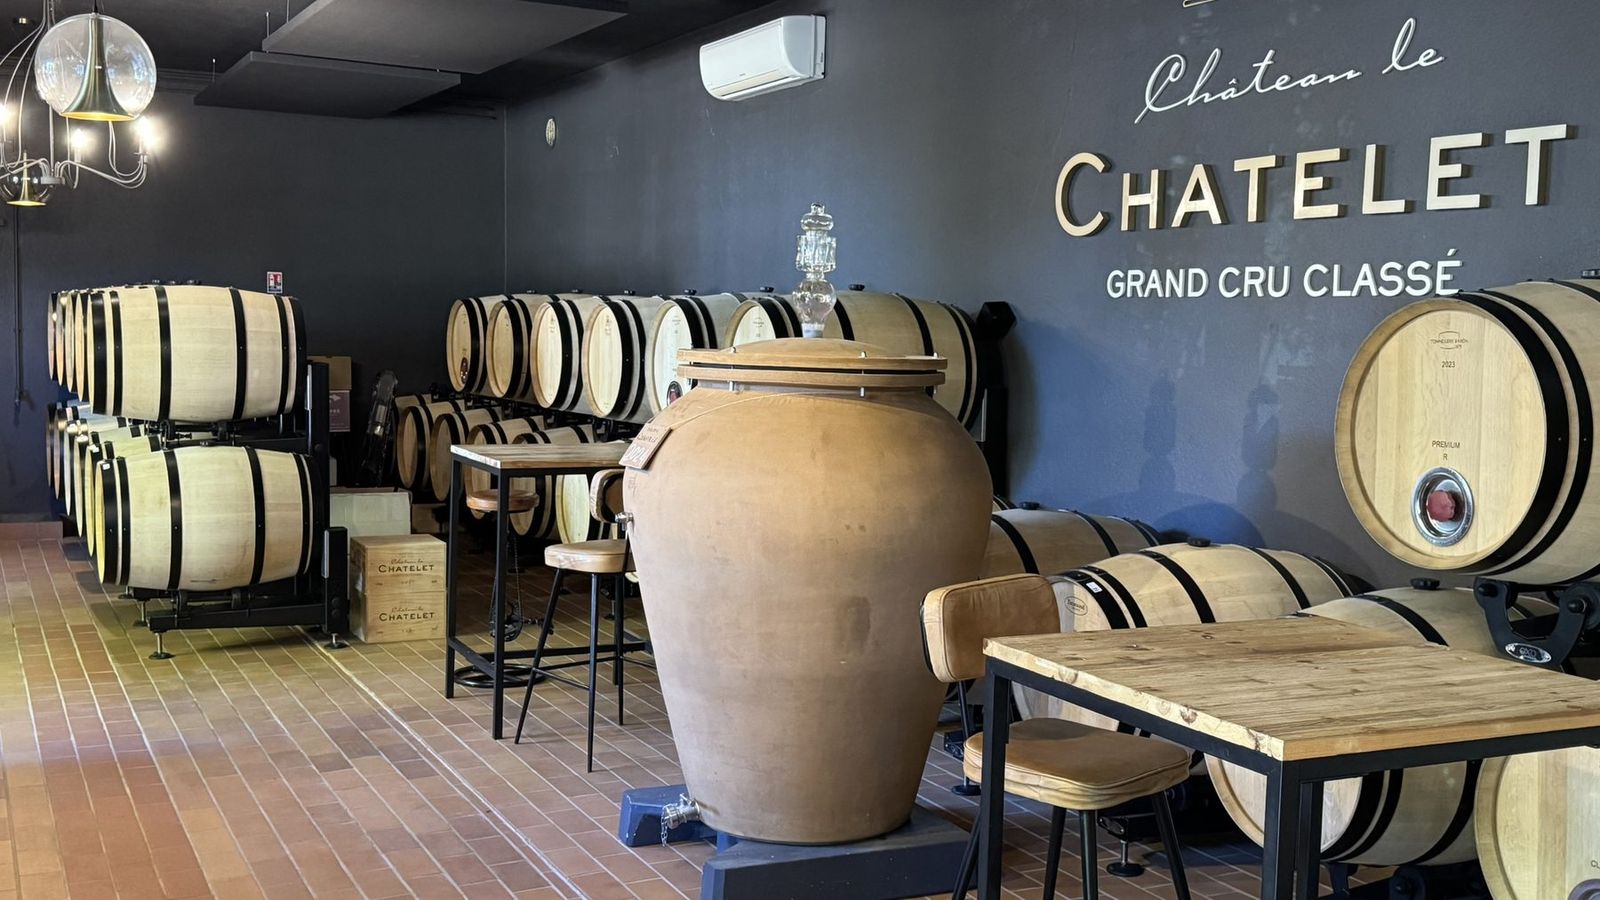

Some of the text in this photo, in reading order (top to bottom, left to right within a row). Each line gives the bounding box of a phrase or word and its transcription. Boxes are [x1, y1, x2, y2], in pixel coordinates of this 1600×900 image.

[1383, 17, 1445, 75] le
[1055, 123, 1570, 237] CHATELET
[1106, 248, 1463, 299] GRAND CRU CLASSÉ
[1431, 440, 1461, 449] PREMIUM
[378, 564, 435, 573] CHATELET
[378, 612, 436, 622] CHATELET
